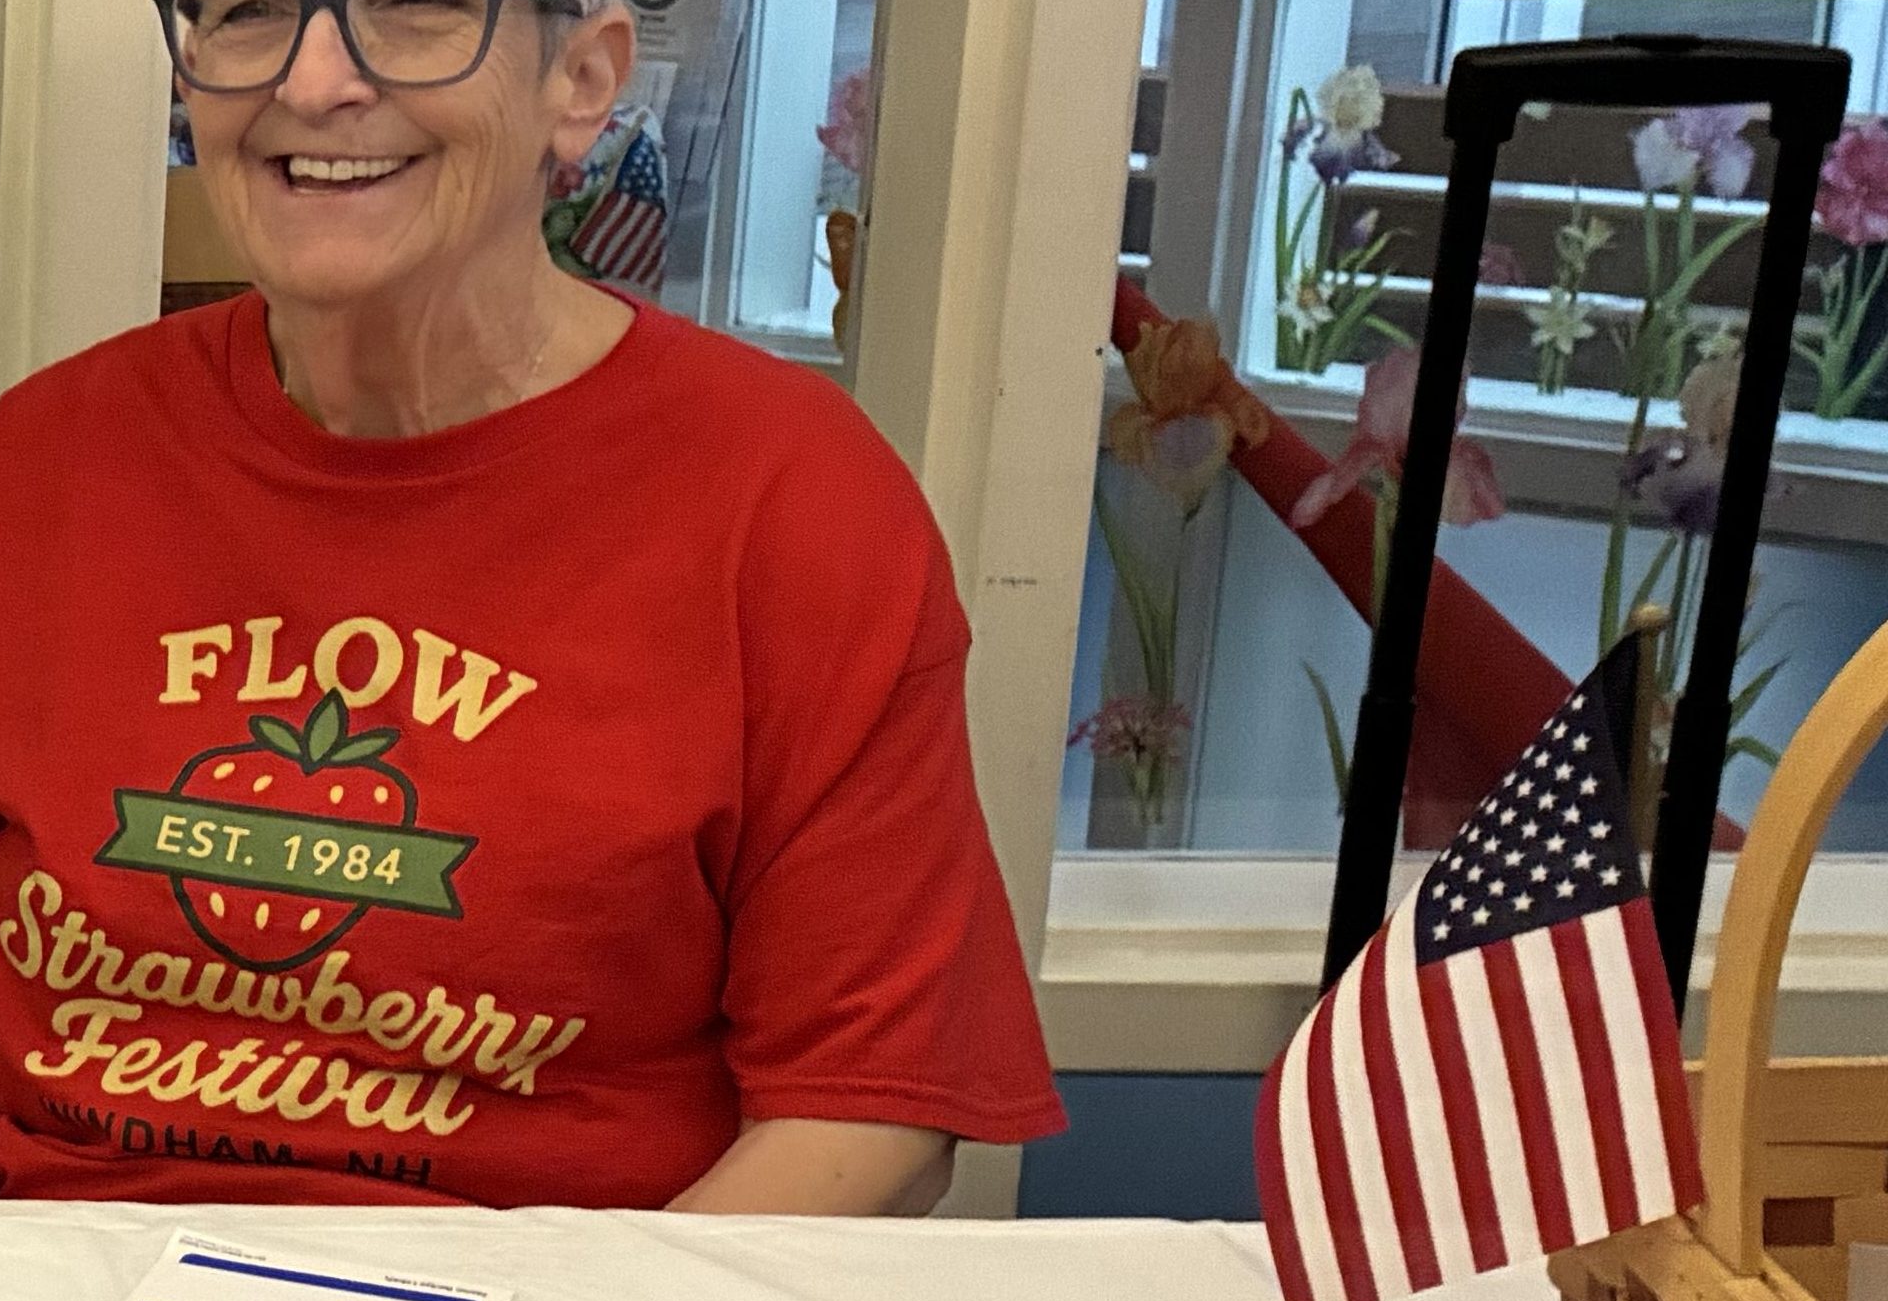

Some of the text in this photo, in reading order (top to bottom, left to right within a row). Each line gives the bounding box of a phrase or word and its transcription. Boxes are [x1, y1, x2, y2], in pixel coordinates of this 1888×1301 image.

[158, 616, 538, 742] FLOW
[154, 814, 403, 886] EST. 1984
[24, 998, 475, 1136] Festival
[346, 1149, 432, 1186] NH
